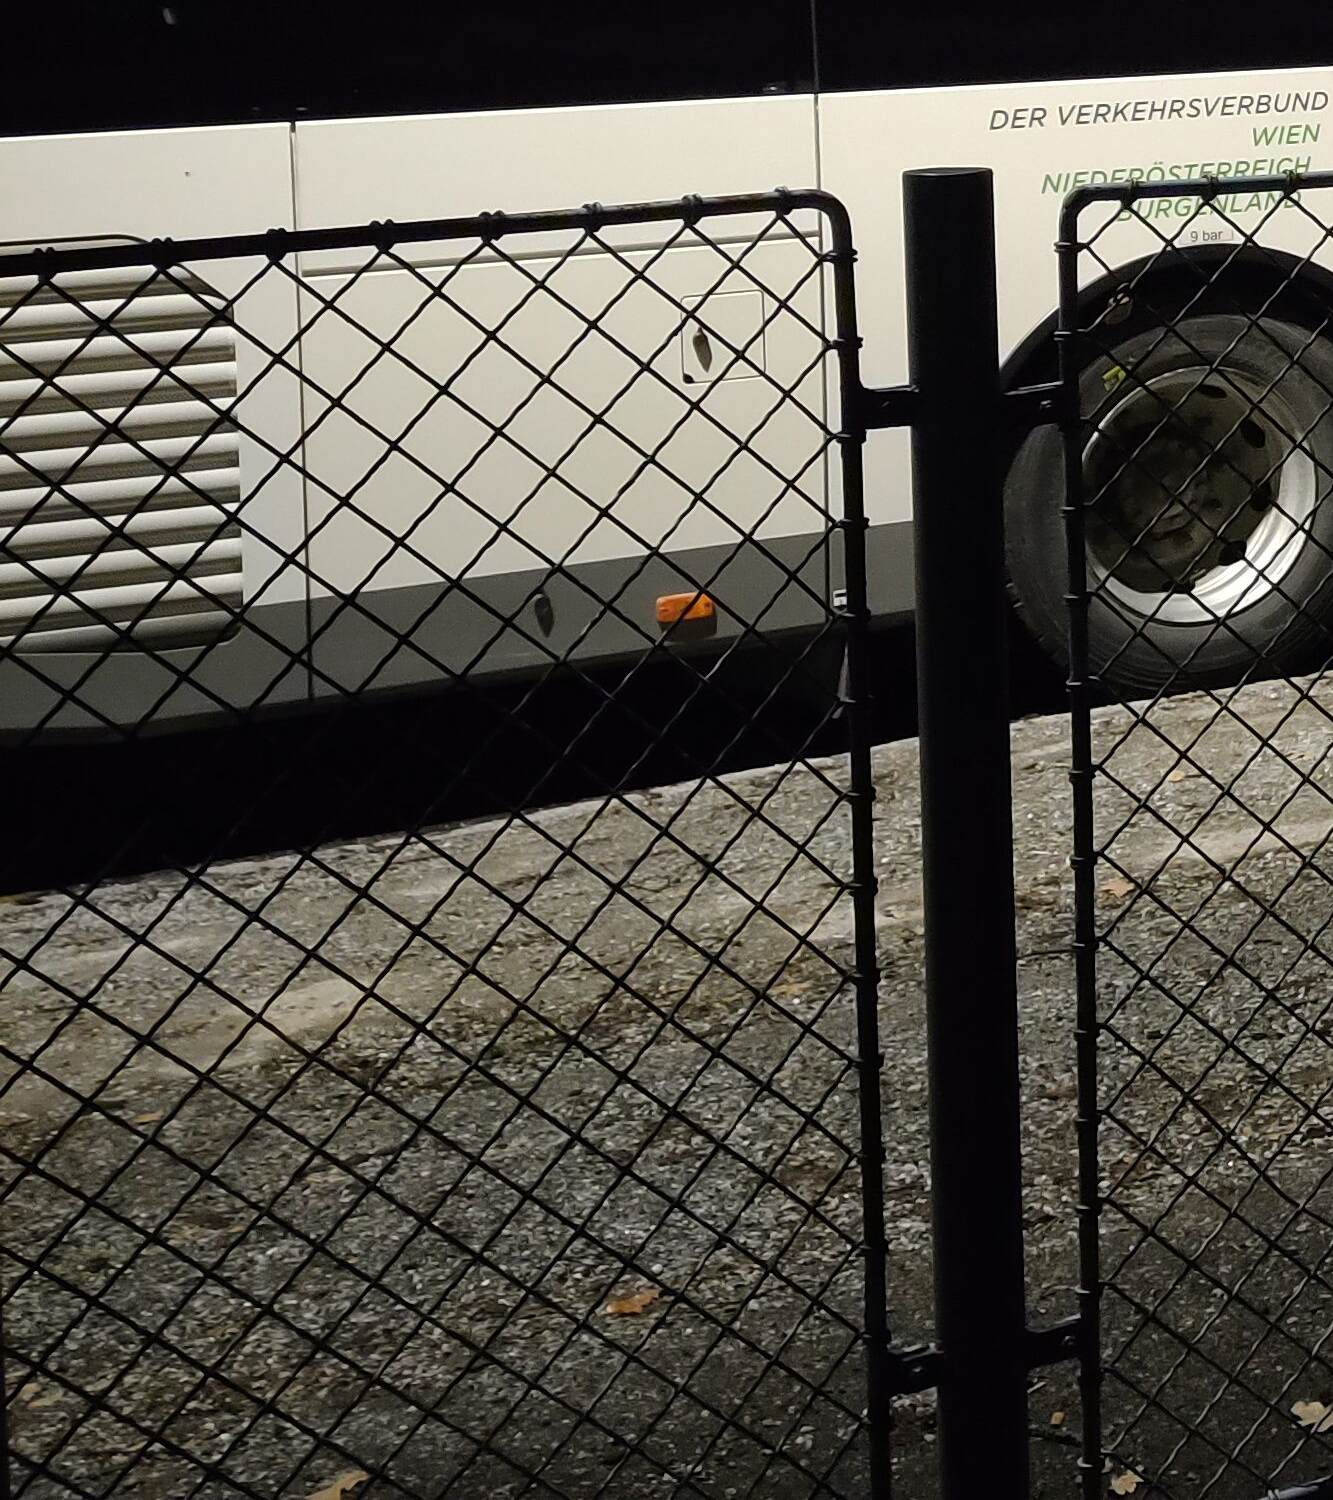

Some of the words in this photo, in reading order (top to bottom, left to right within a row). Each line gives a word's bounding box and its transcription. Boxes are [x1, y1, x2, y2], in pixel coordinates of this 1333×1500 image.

[988, 106, 1048, 131] DER
[1057, 90, 1330, 127] VERKEHRSVERBUND
[1251, 123, 1321, 148] WIEN
[1041, 155, 1312, 195] NIEDERÖSTERREICH
[1190, 231, 1199, 243] 9
[1202, 229, 1224, 242] bar
